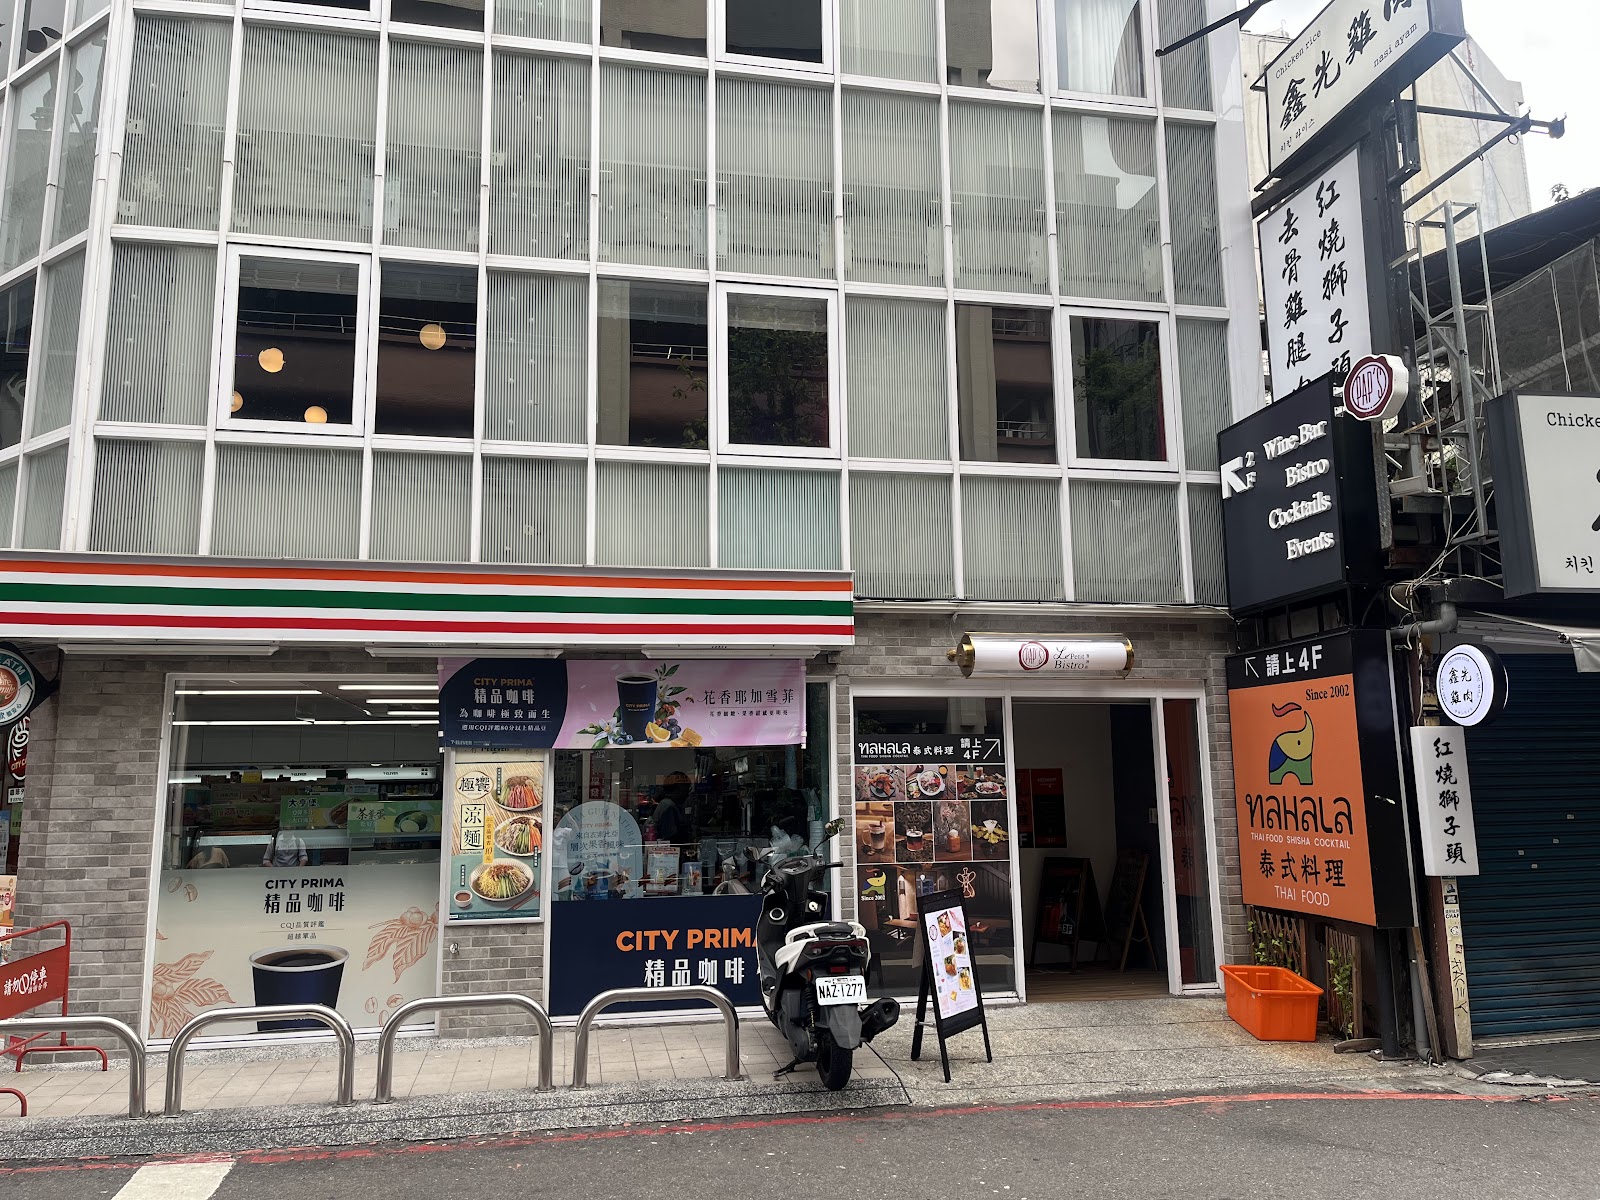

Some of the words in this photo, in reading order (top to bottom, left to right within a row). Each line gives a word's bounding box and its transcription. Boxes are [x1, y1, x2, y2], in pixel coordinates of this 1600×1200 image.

[1275, 48, 1304, 79] Chicken
[1305, 29, 1322, 49] rice
[1373, 45, 1392, 68] nasi
[1394, 22, 1417, 48] ayam
[1355, 366, 1383, 407] PAP'S
[1262, 434, 1299, 461] Wine
[1298, 420, 1328, 446] Bar
[1285, 458, 1331, 488] Bistro
[1268, 491, 1333, 530] Cocktails
[1285, 531, 1336, 560] Events
[1565, 555, 1594, 574] 치킨
[1054, 660, 1085, 670] Bistro
[473, 678, 498, 686] CITY
[501, 678, 534, 687] PRIMA
[1305, 688, 1328, 701] Since
[1329, 684, 1350, 698] 2002
[473, 687, 535, 705] 精品咖啡
[702, 688, 795, 706] 花香耶加雪菲
[459, 707, 551, 719] 為咖啡極致而生
[912, 745, 955, 756] 泰式料理
[959, 737, 982, 749] 請上
[963, 749, 980, 760] 4F
[1433, 737, 1467, 865] 紅燒獅子頭
[463, 806, 483, 848] 涼麵
[1250, 832, 1264, 842] THAI
[1265, 834, 1284, 843] FOOD
[1286, 836, 1311, 846] SHISHA
[1314, 838, 1351, 849] COCKTAIL
[1259, 848, 1346, 887] 泰式料理
[265, 878, 298, 889] CITY
[301, 877, 345, 889] PRIMA
[263, 891, 346, 914] 精品咖啡
[1274, 885, 1297, 901] THAI
[1301, 889, 1330, 907] FOOD
[615, 929, 680, 952] CITY
[686, 926, 757, 950] PRIM
[643, 957, 745, 988] 精品咖啡
